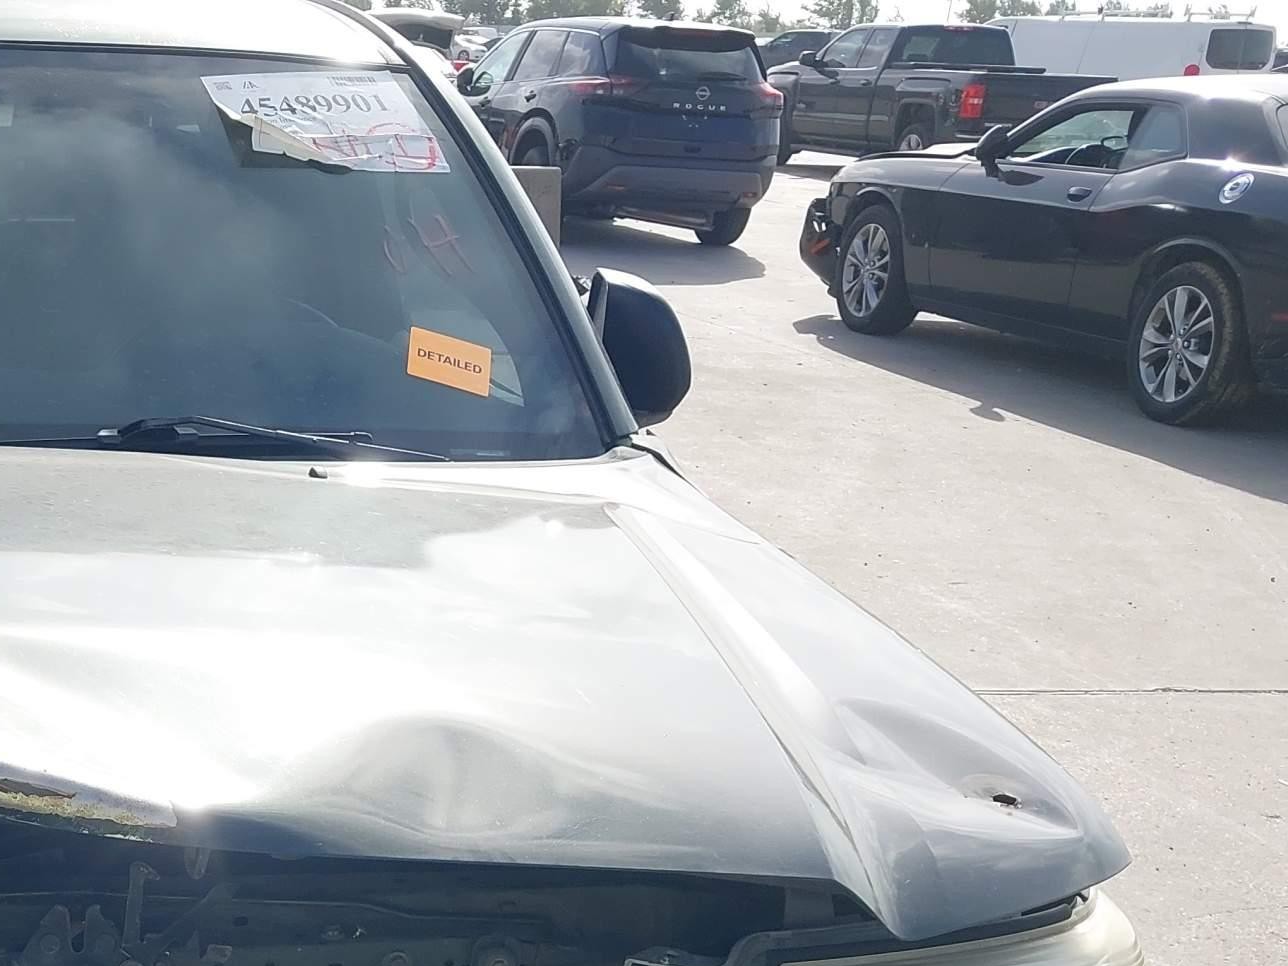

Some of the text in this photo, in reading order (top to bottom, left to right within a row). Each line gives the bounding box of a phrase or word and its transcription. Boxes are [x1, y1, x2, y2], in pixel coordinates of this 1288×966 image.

[240, 94, 391, 117] 45489901
[673, 102, 726, 112] ROGUE
[417, 348, 483, 374] DETAILED
